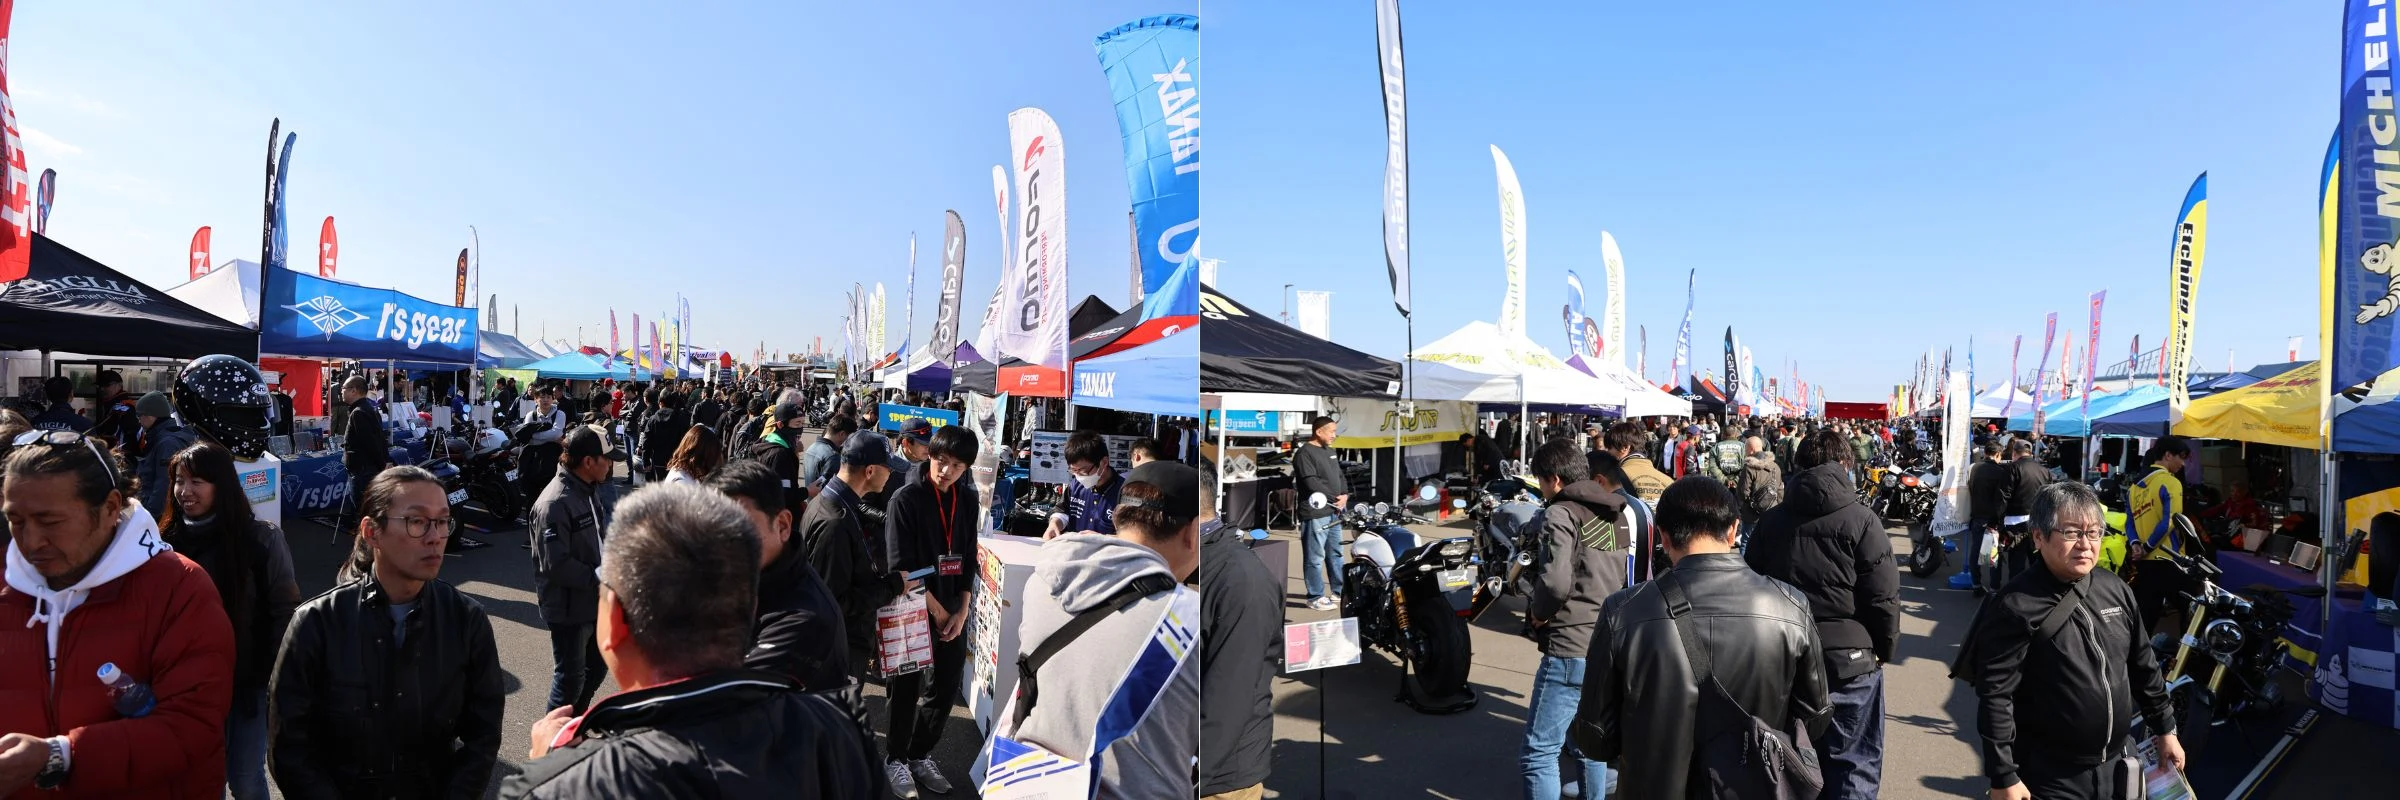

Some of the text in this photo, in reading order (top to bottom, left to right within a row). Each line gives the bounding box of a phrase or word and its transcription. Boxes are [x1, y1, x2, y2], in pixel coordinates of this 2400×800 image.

[2179, 222, 2194, 314] Etching
[408, 311, 467, 350] gear
[1080, 371, 1117, 398] TANAX
[1727, 353, 1740, 392] cardo
[970, 465, 993, 473] orma
[320, 481, 353, 508] gea
